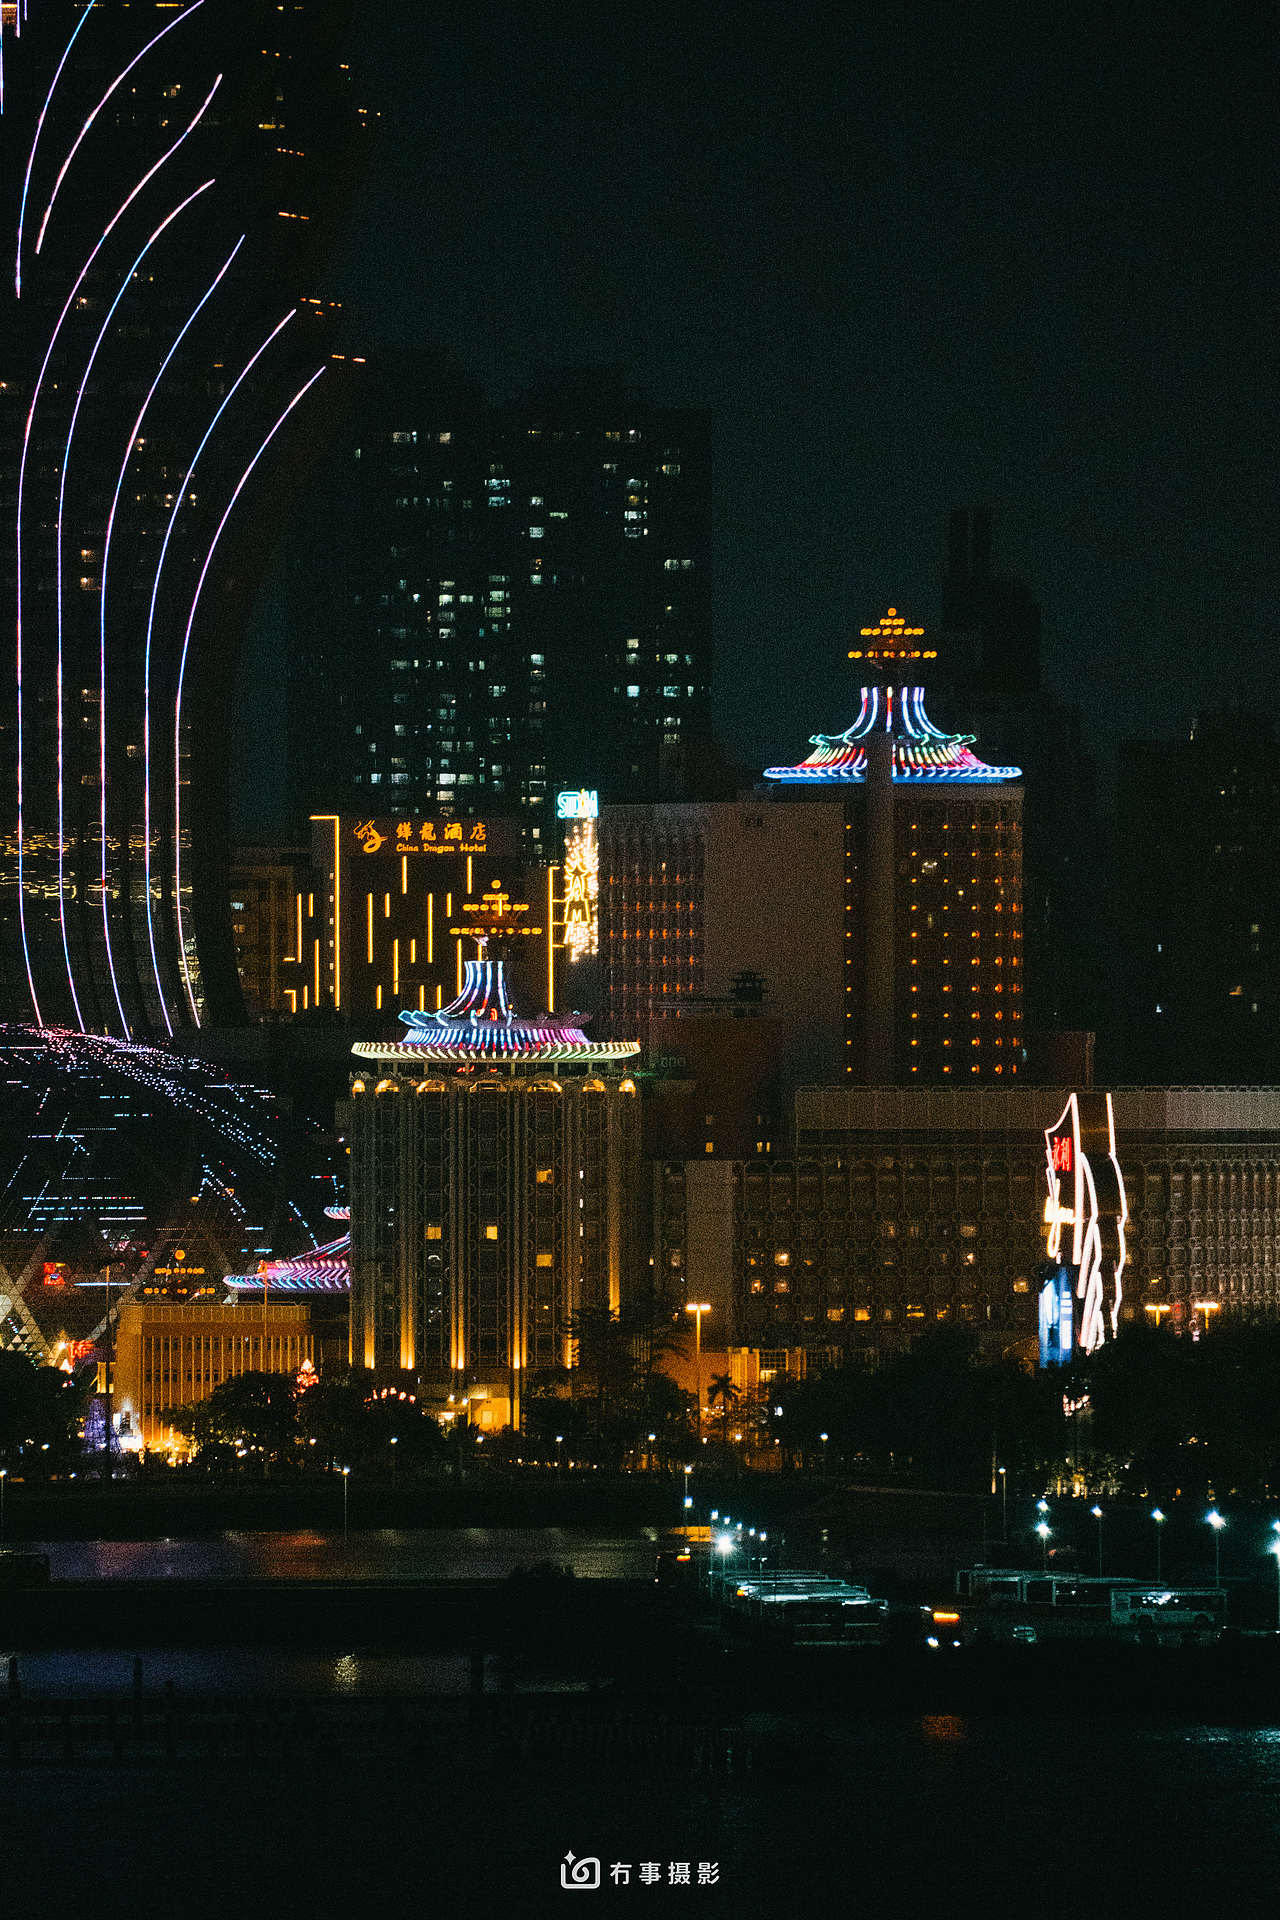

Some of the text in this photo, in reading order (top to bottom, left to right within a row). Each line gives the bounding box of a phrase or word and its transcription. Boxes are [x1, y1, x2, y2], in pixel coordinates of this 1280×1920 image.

[396, 842, 487, 854] China Dragon Hotel
